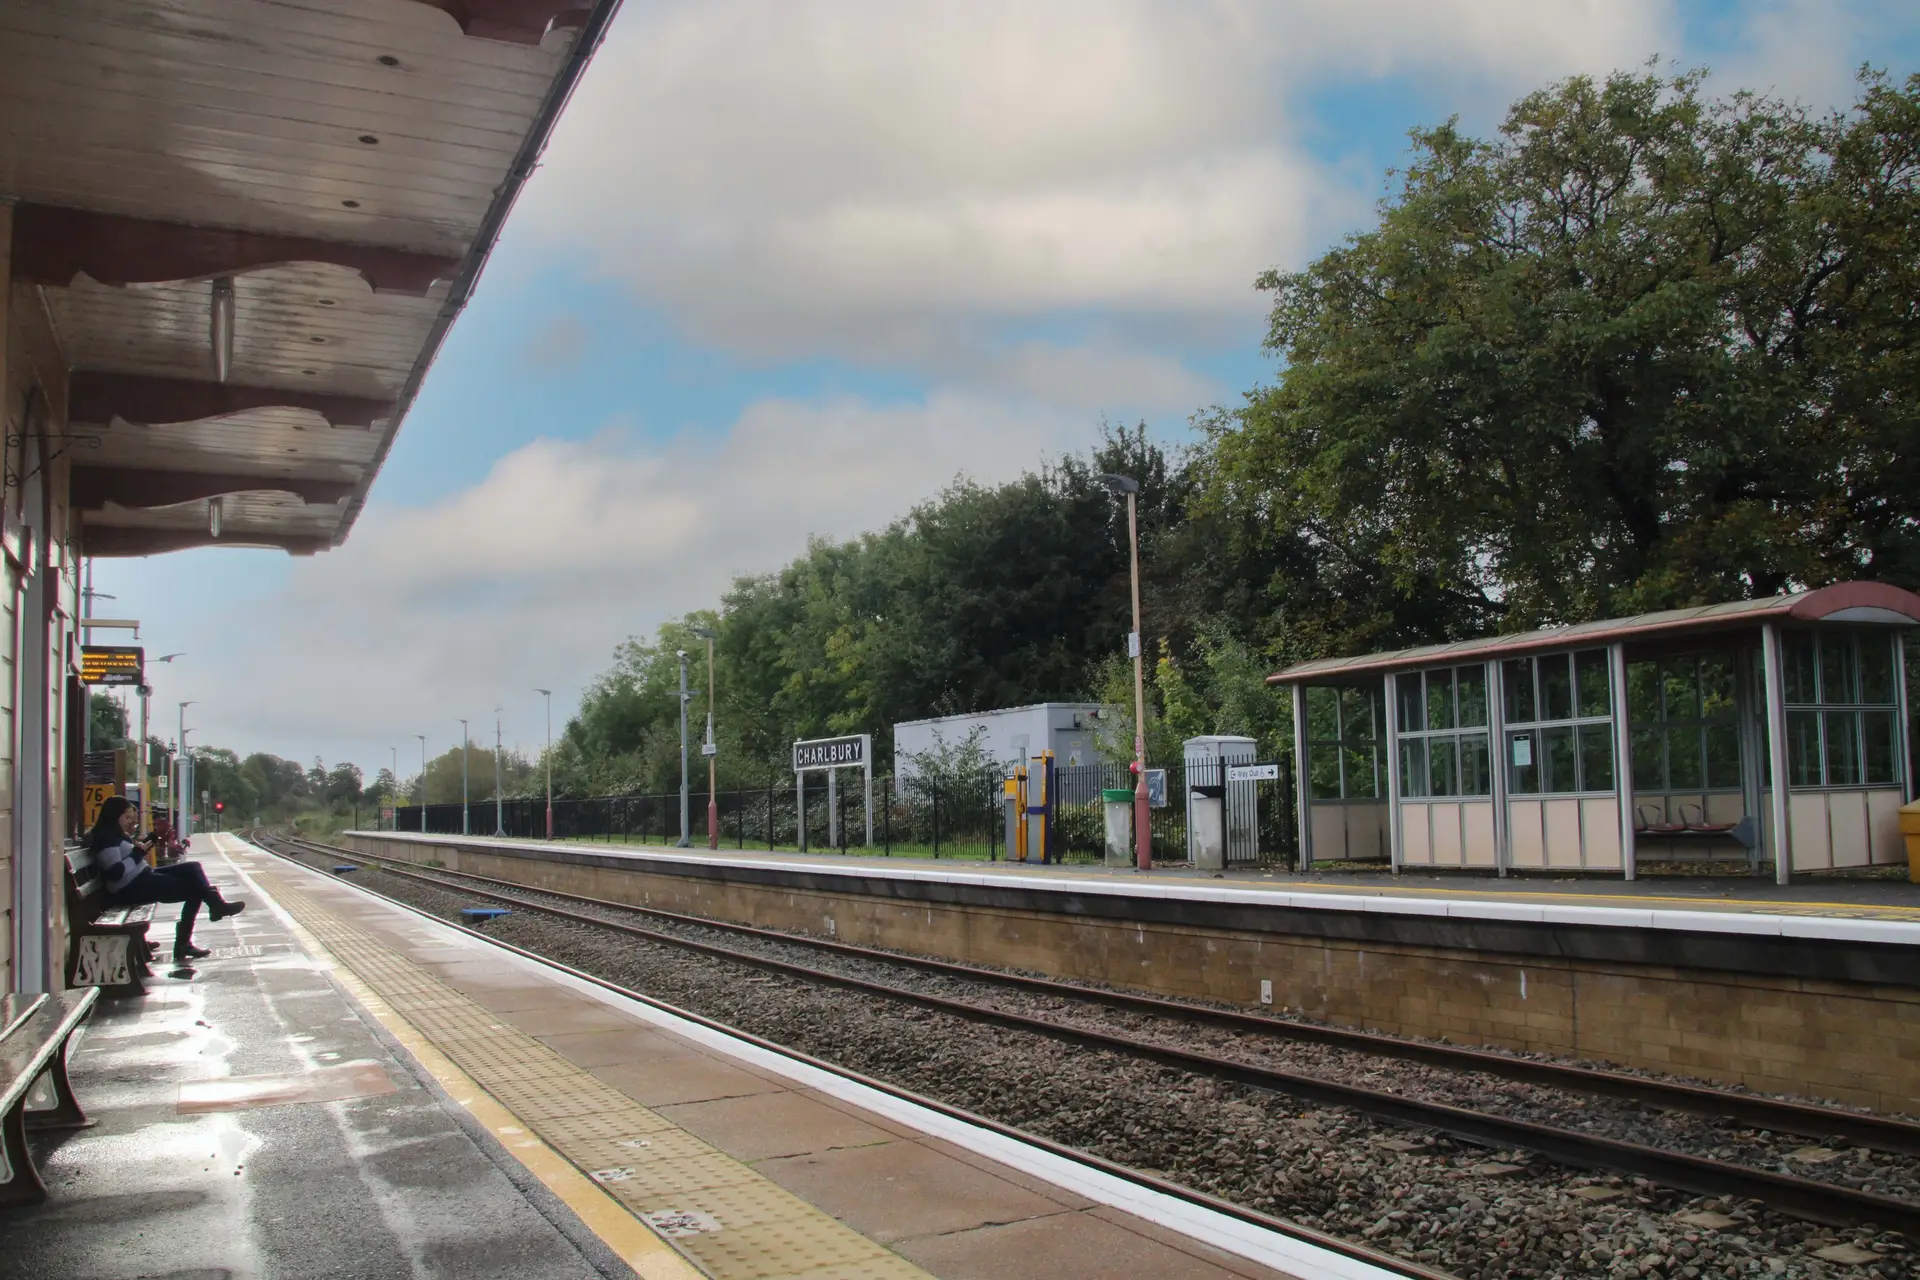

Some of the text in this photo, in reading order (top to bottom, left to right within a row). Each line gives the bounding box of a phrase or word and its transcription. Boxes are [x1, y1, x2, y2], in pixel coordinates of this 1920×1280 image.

[797, 742, 861, 764] CHARLBURY
[1249, 769, 1259, 777] Out
[84, 787, 104, 802] 76
